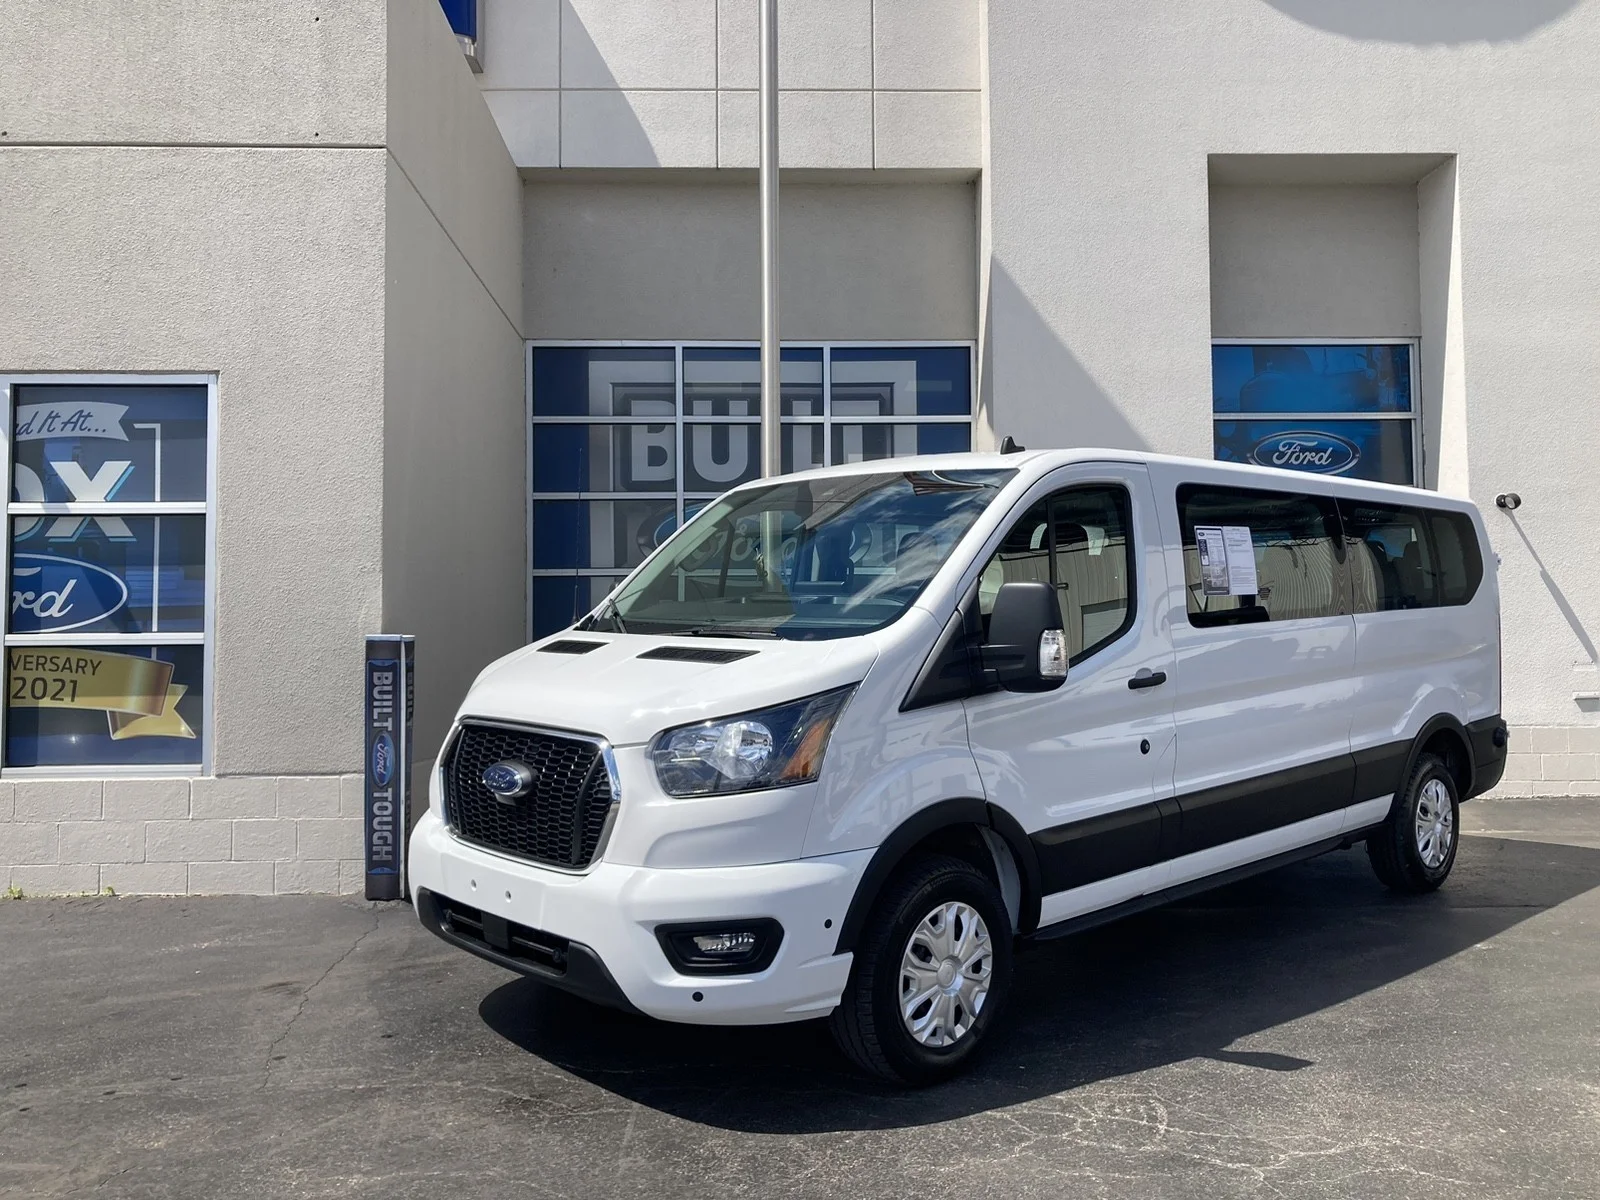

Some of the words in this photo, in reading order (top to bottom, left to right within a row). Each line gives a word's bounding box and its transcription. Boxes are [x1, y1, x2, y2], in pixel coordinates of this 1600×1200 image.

[15, 411, 39, 436] d
[36, 410, 61, 433] It
[631, 400, 879, 482] BULT
[1272, 439, 1332, 466] Ford
[12, 677, 78, 702] 2021
[372, 671, 393, 731] BUILT
[377, 743, 391, 775] Ford
[487, 769, 511, 788] Ford
[372, 788, 393, 861] TOUGH
